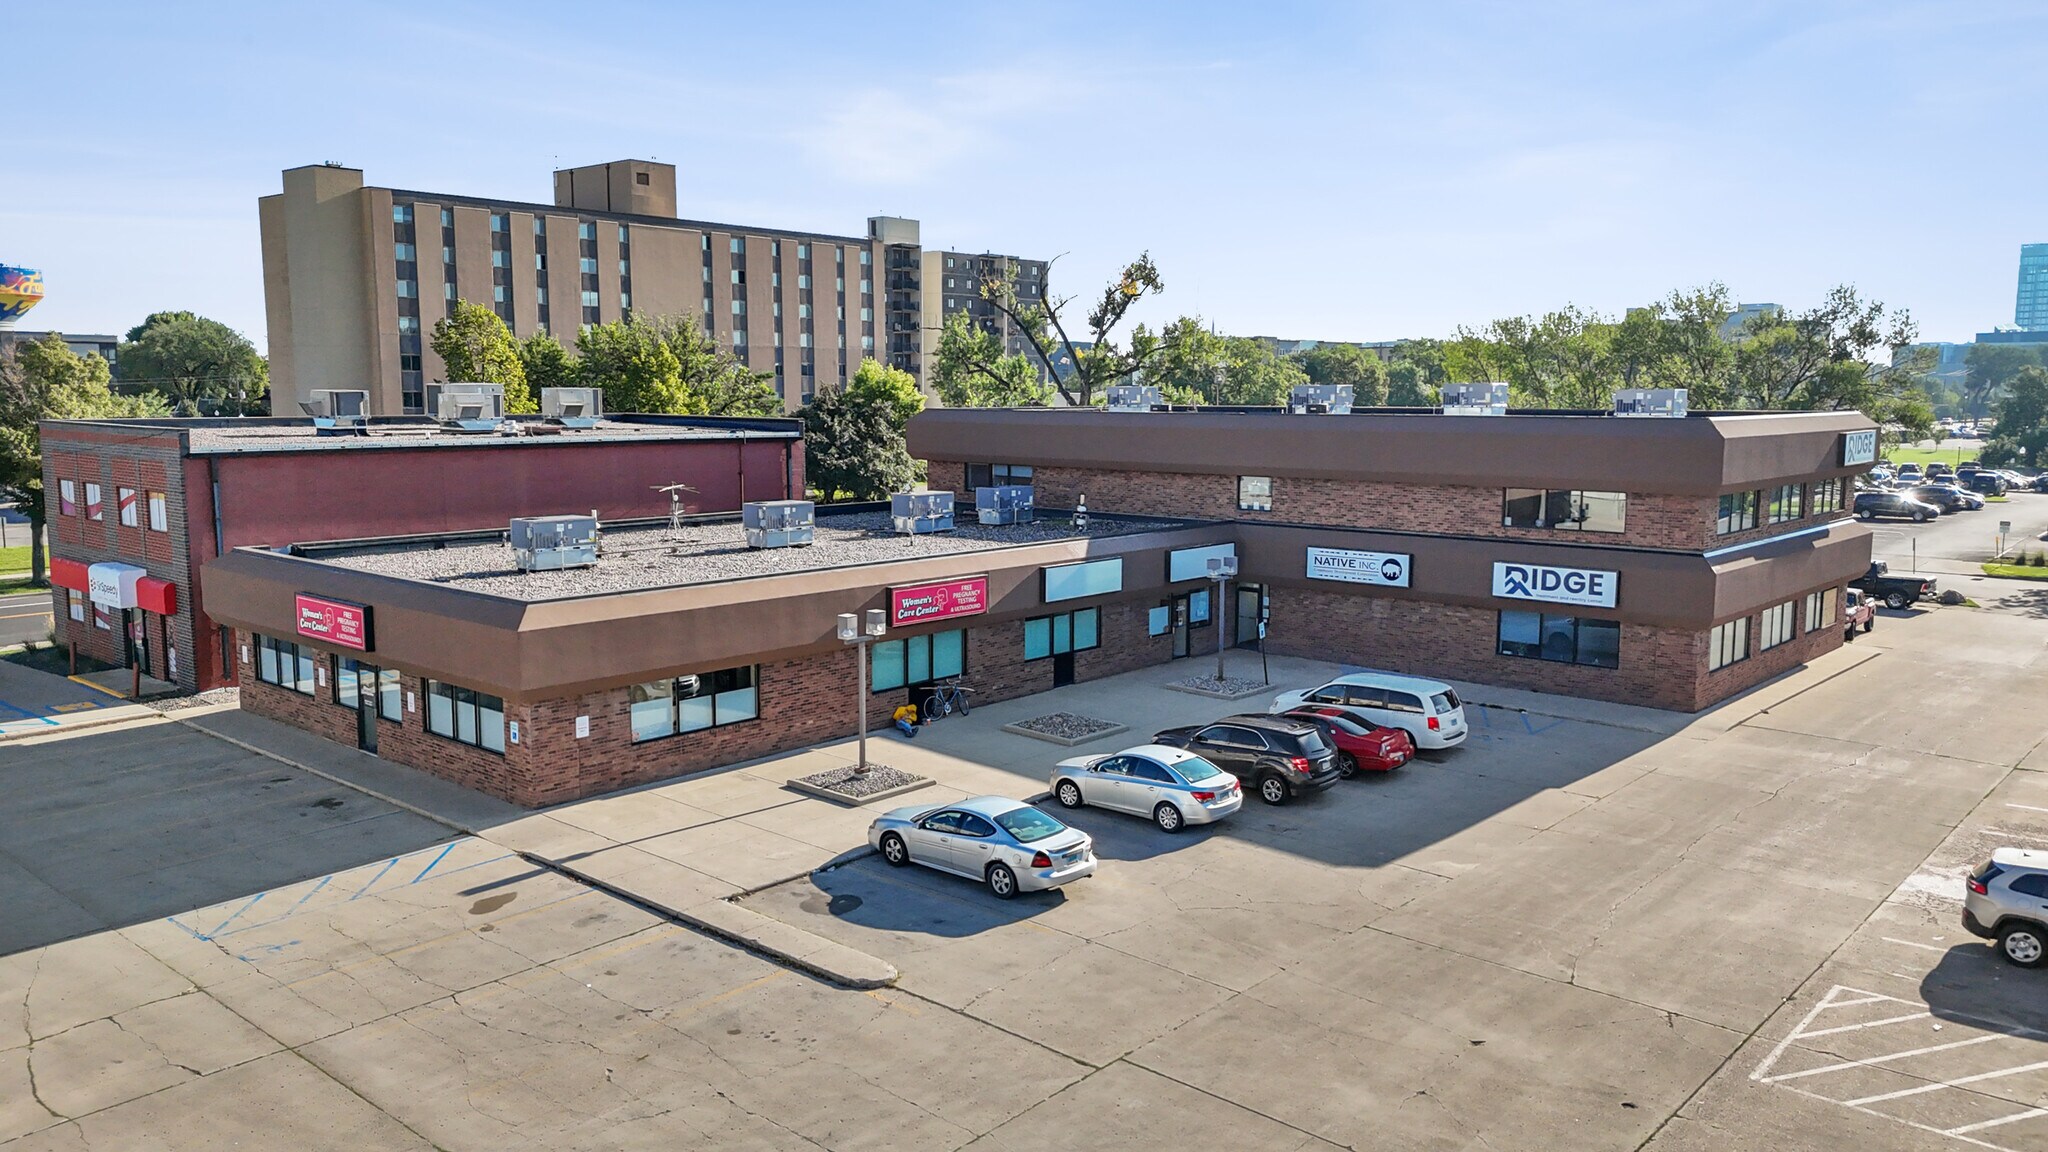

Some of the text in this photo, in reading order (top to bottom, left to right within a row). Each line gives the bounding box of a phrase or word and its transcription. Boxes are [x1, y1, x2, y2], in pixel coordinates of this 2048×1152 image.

[1847, 433, 1873, 463] RIDGE
[1313, 556, 1379, 571] NATIVE INC.
[1504, 565, 1604, 597] RIDGE
[952, 589, 981, 599] PREGNANCY
[957, 596, 977, 604] TESTING
[901, 595, 932, 608] Women's
[301, 607, 323, 620] Women's
[897, 606, 939, 620] Care Center
[299, 618, 328, 633] Care Center
